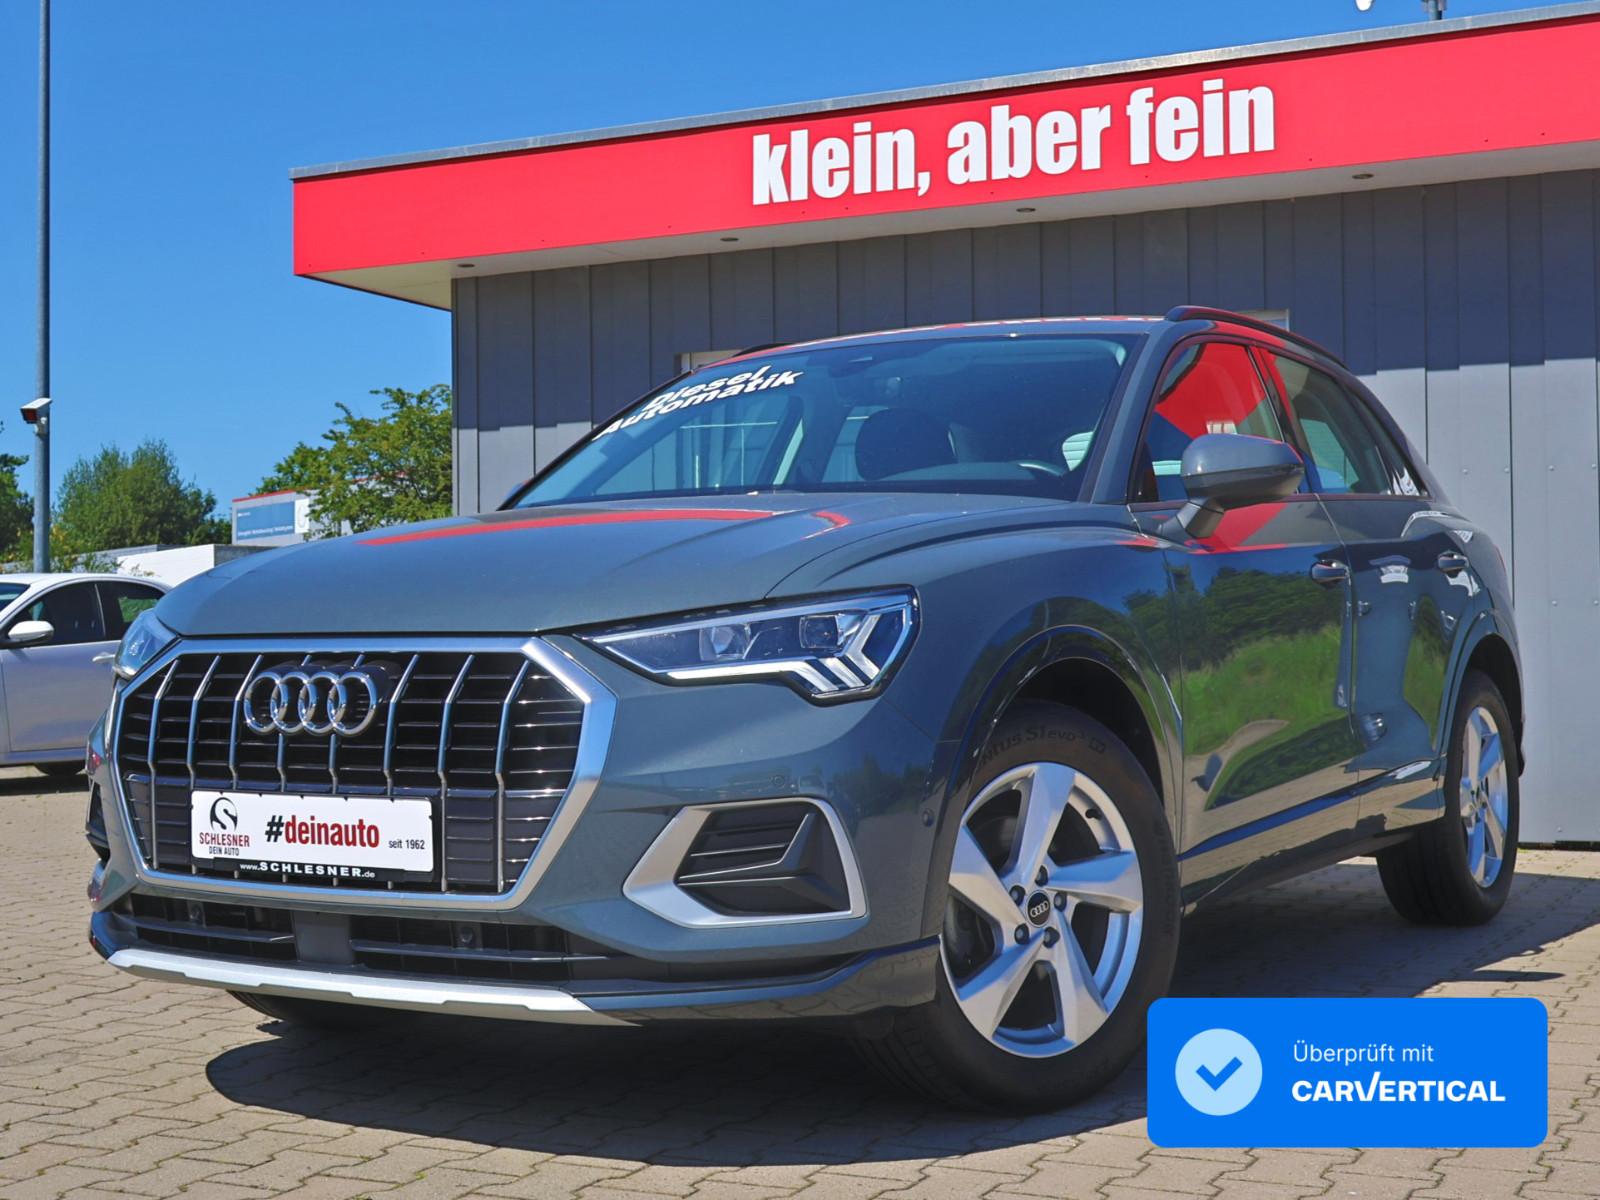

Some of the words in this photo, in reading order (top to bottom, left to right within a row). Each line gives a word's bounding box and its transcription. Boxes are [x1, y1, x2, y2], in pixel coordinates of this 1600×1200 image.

[752, 121, 930, 206] klein,
[947, 103, 1111, 186] aber
[1126, 78, 1275, 167] fein
[592, 371, 804, 442] Automatik
[199, 831, 250, 848] SCHLESNER
[264, 815, 380, 849] #deinauto
[209, 846, 222, 855] DEIN
[224, 847, 240, 857] AUTO
[388, 839, 403, 850] seit
[406, 839, 426, 850] 1962
[240, 861, 376, 879] www.SCHLESNER.de
